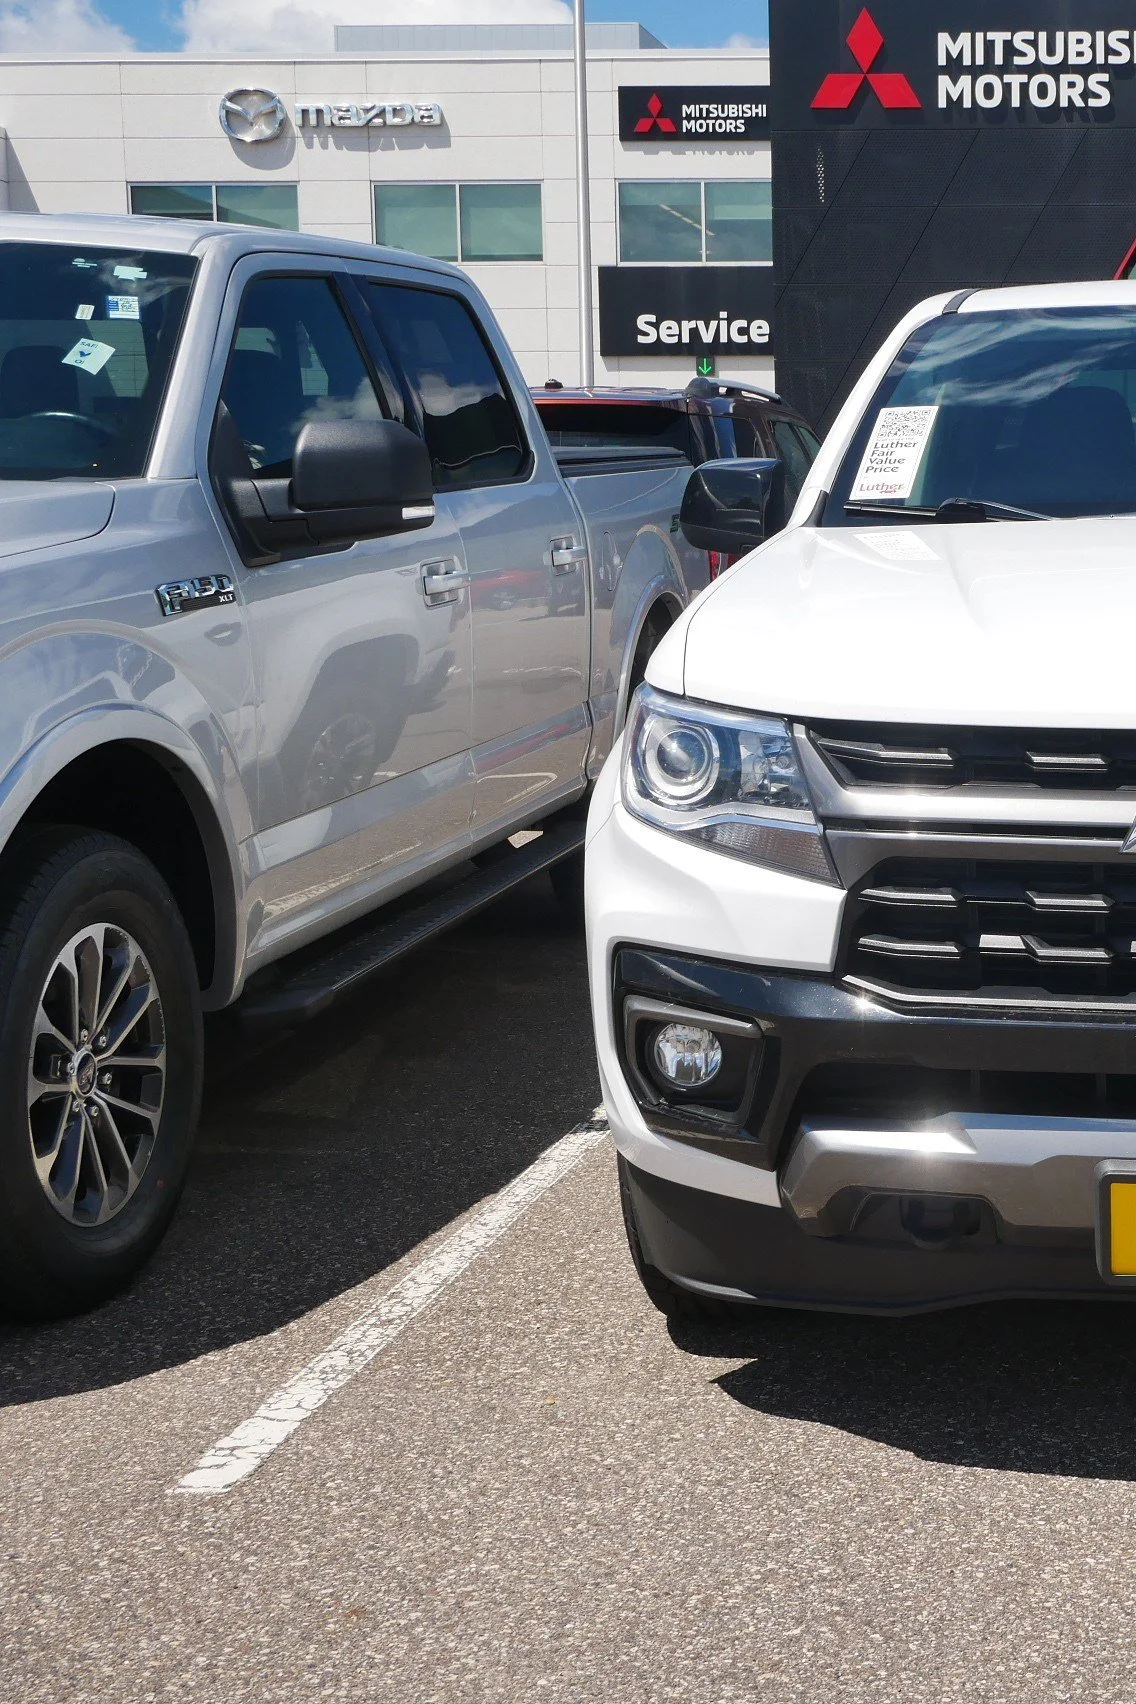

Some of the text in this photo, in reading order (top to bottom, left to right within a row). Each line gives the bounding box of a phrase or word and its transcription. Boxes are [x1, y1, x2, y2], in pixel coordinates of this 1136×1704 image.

[937, 73, 1111, 109] MOTORS
[681, 103, 767, 118] MITSUBISHI
[682, 119, 746, 133] MOTORS
[636, 311, 770, 344] Service
[873, 440, 919, 449] Luther
[870, 449, 896, 457] Fair
[868, 456, 906, 465] Value
[865, 465, 900, 474] Price
[859, 482, 904, 492] Luther
[218, 594, 234, 603] XLT
